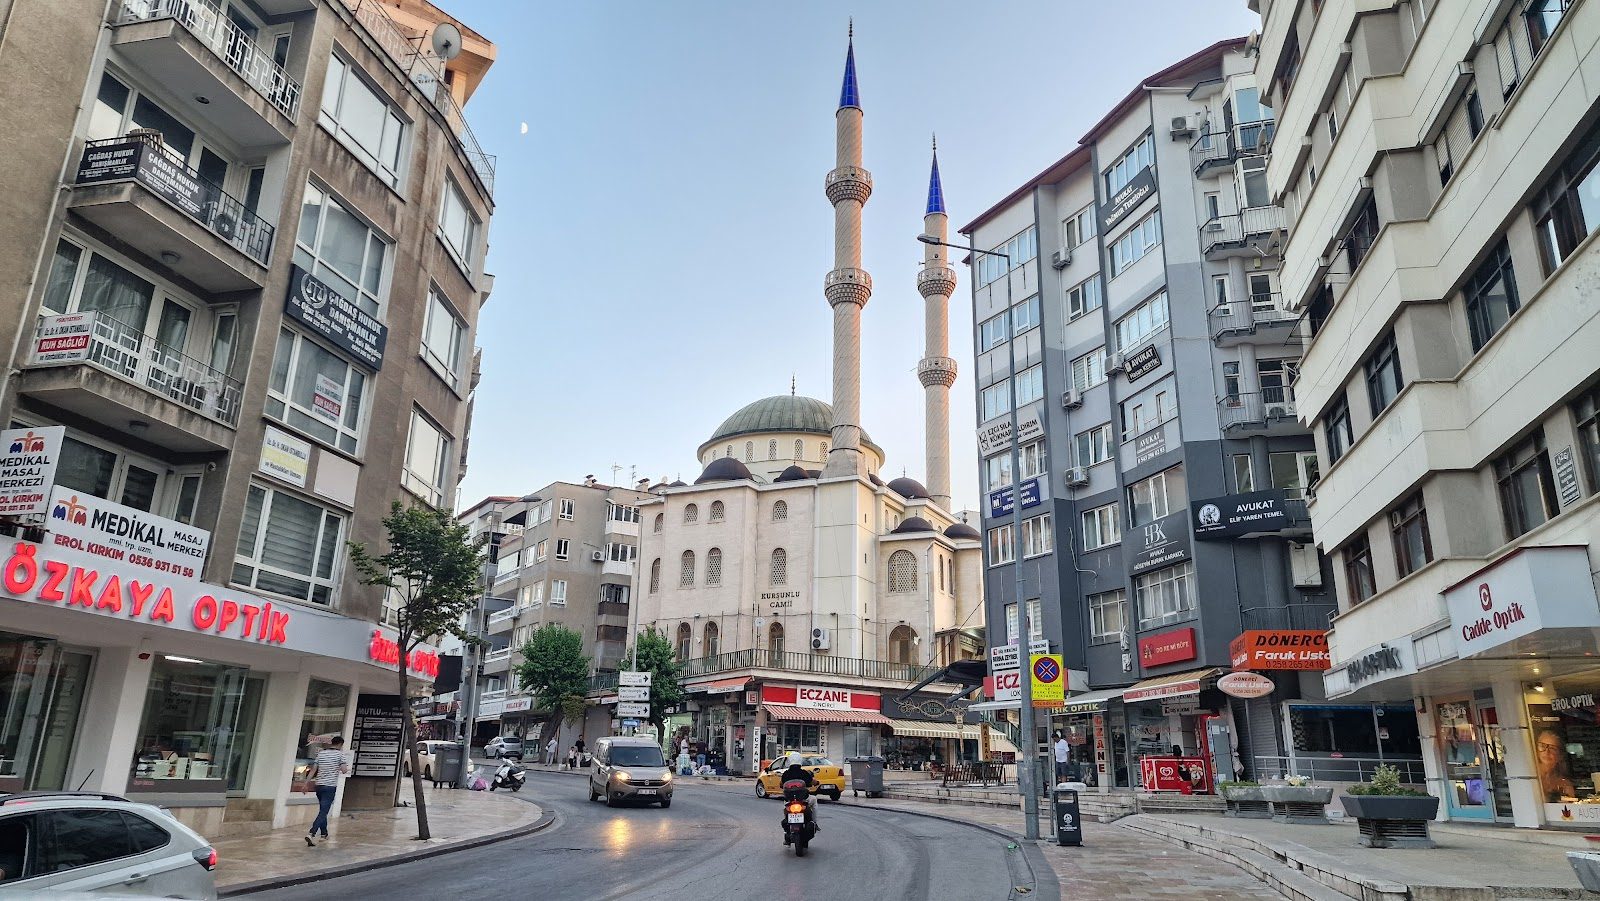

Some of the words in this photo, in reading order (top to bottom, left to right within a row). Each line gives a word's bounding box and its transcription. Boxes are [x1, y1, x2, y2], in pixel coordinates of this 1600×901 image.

[148, 152, 175, 178] ÇAĞDAŞ
[175, 170, 200, 194] HUKUK
[151, 167, 192, 198] DANIŞMANLIK
[1115, 185, 1133, 205] AVUKAT
[328, 291, 358, 320] ÇAĞDAŞ
[357, 311, 382, 335] HUKUK
[328, 307, 377, 346] DANIŞMANLIK
[41, 339, 57, 350] RUH
[1131, 348, 1154, 368] AVUKAT
[987, 423, 1000, 436] EZGİ
[1017, 418, 1038, 433] ILDIRIM
[1139, 431, 1161, 447] AVUKAT
[0, 455, 50, 468] MEDİKAL
[1, 468, 41, 478] MASAJ
[0, 495, 10, 504] OL
[12, 493, 44, 503] KIRKIM
[1236, 500, 1275, 513] AVUKAT
[1242, 513, 1262, 522] YAREN
[1263, 511, 1284, 519] TEMEL
[91, 509, 165, 547] MEDİKAL
[173, 531, 204, 546] MASAJ
[53, 533, 85, 551] EROL
[86, 540, 125, 561] KIRKIM
[128, 553, 154, 568] 0536
[154, 559, 171, 572] 931
[171, 564, 182, 575] 51
[182, 566, 194, 578] 58
[167, 543, 206, 559] MERKEZİ
[1149, 548, 1165, 558] AVUKAT
[3, 542, 176, 623] ÖZKAYA
[761, 591, 800, 600] KURŞUNLU
[769, 600, 793, 608] CAMİİ
[192, 594, 292, 643] OPTİK
[1462, 617, 1493, 642] Cadde
[1493, 602, 1525, 630] Optik
[369, 630, 411, 668] ÖZKAA
[414, 650, 441, 677] OPTİK
[1255, 650, 1296, 660] Faruk
[1300, 651, 1332, 660] Usta
[996, 672, 1020, 690] ECZ
[800, 688, 848, 703] ECZANE
[1551, 696, 1571, 711] EROL
[1571, 691, 1595, 708] OPTİK
[357, 707, 382, 716] MUTLU
